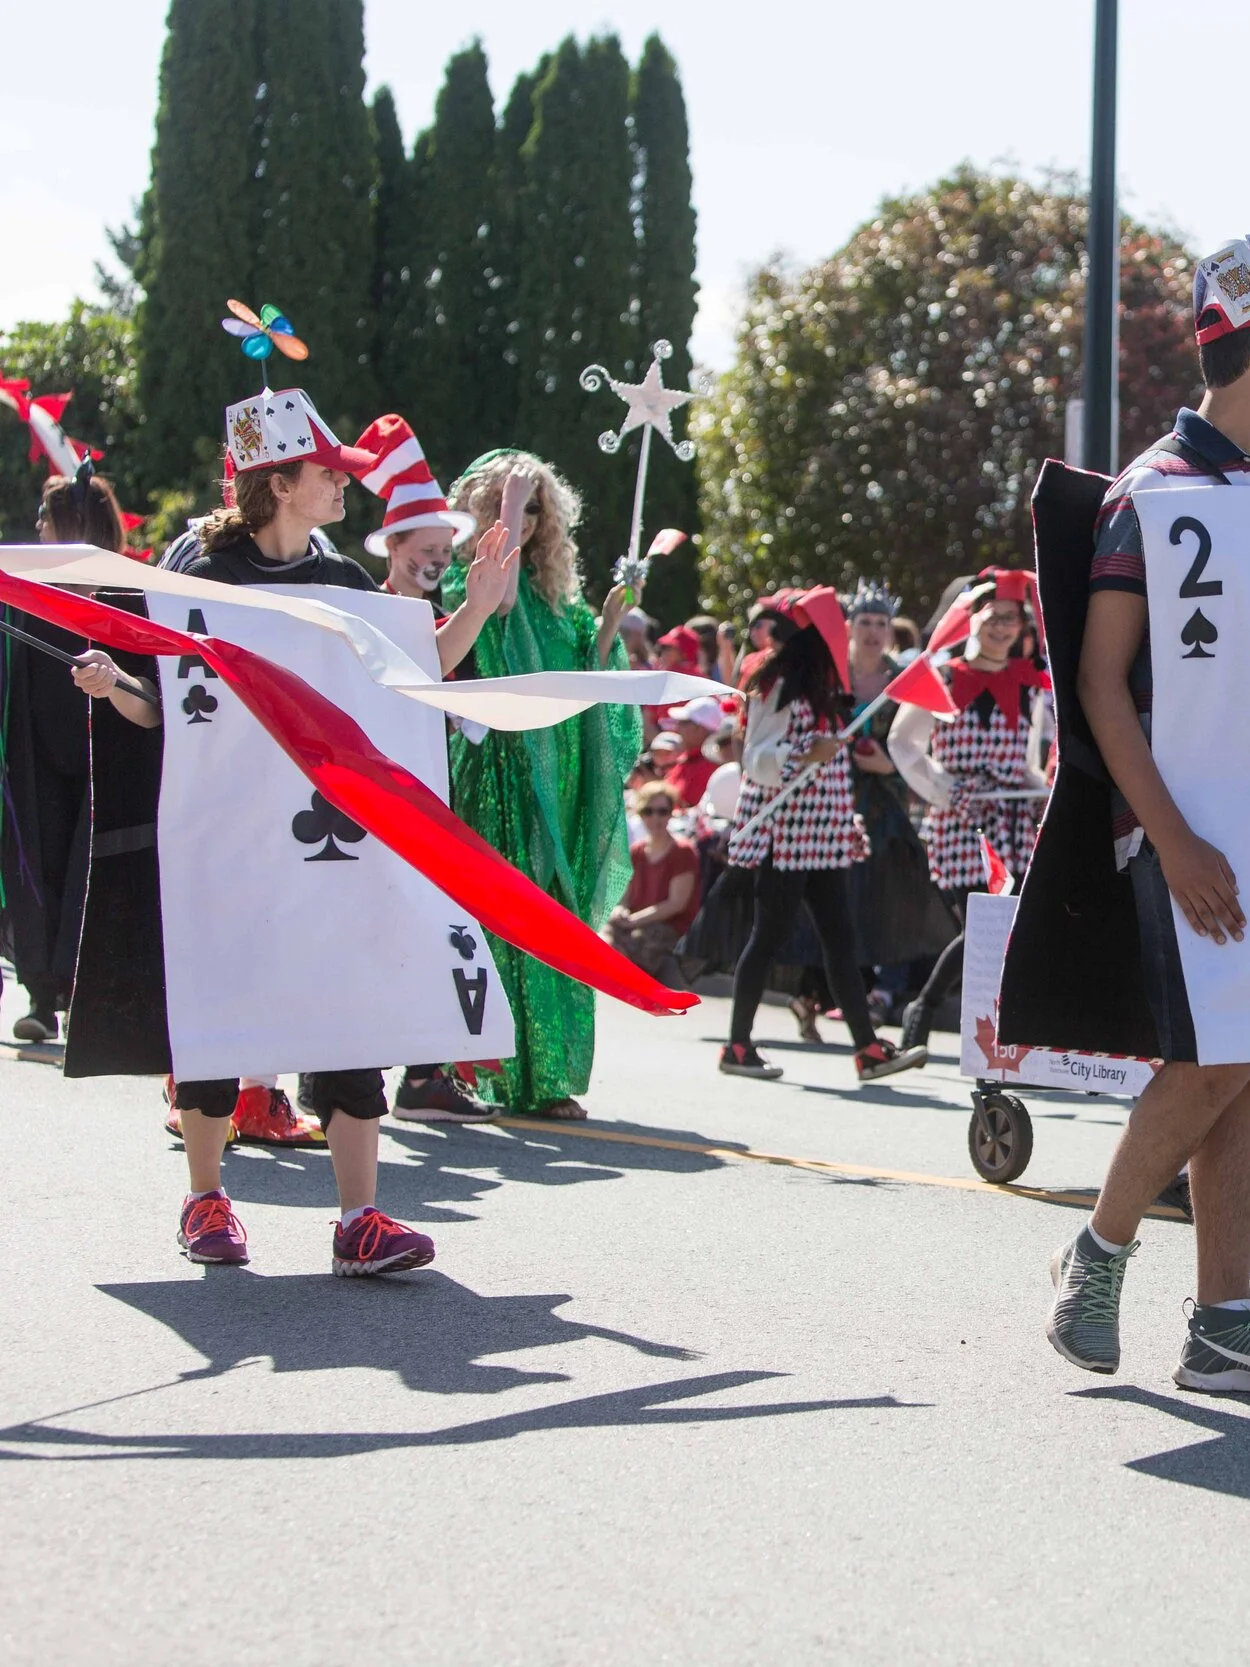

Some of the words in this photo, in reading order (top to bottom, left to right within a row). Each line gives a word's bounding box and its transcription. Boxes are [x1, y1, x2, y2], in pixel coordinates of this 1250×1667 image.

[1169, 516, 1223, 599] 2
[177, 608, 219, 679] A
[452, 966, 488, 1036] A
[1070, 1061, 1092, 1081] City
[1093, 1064, 1127, 1085] Library
